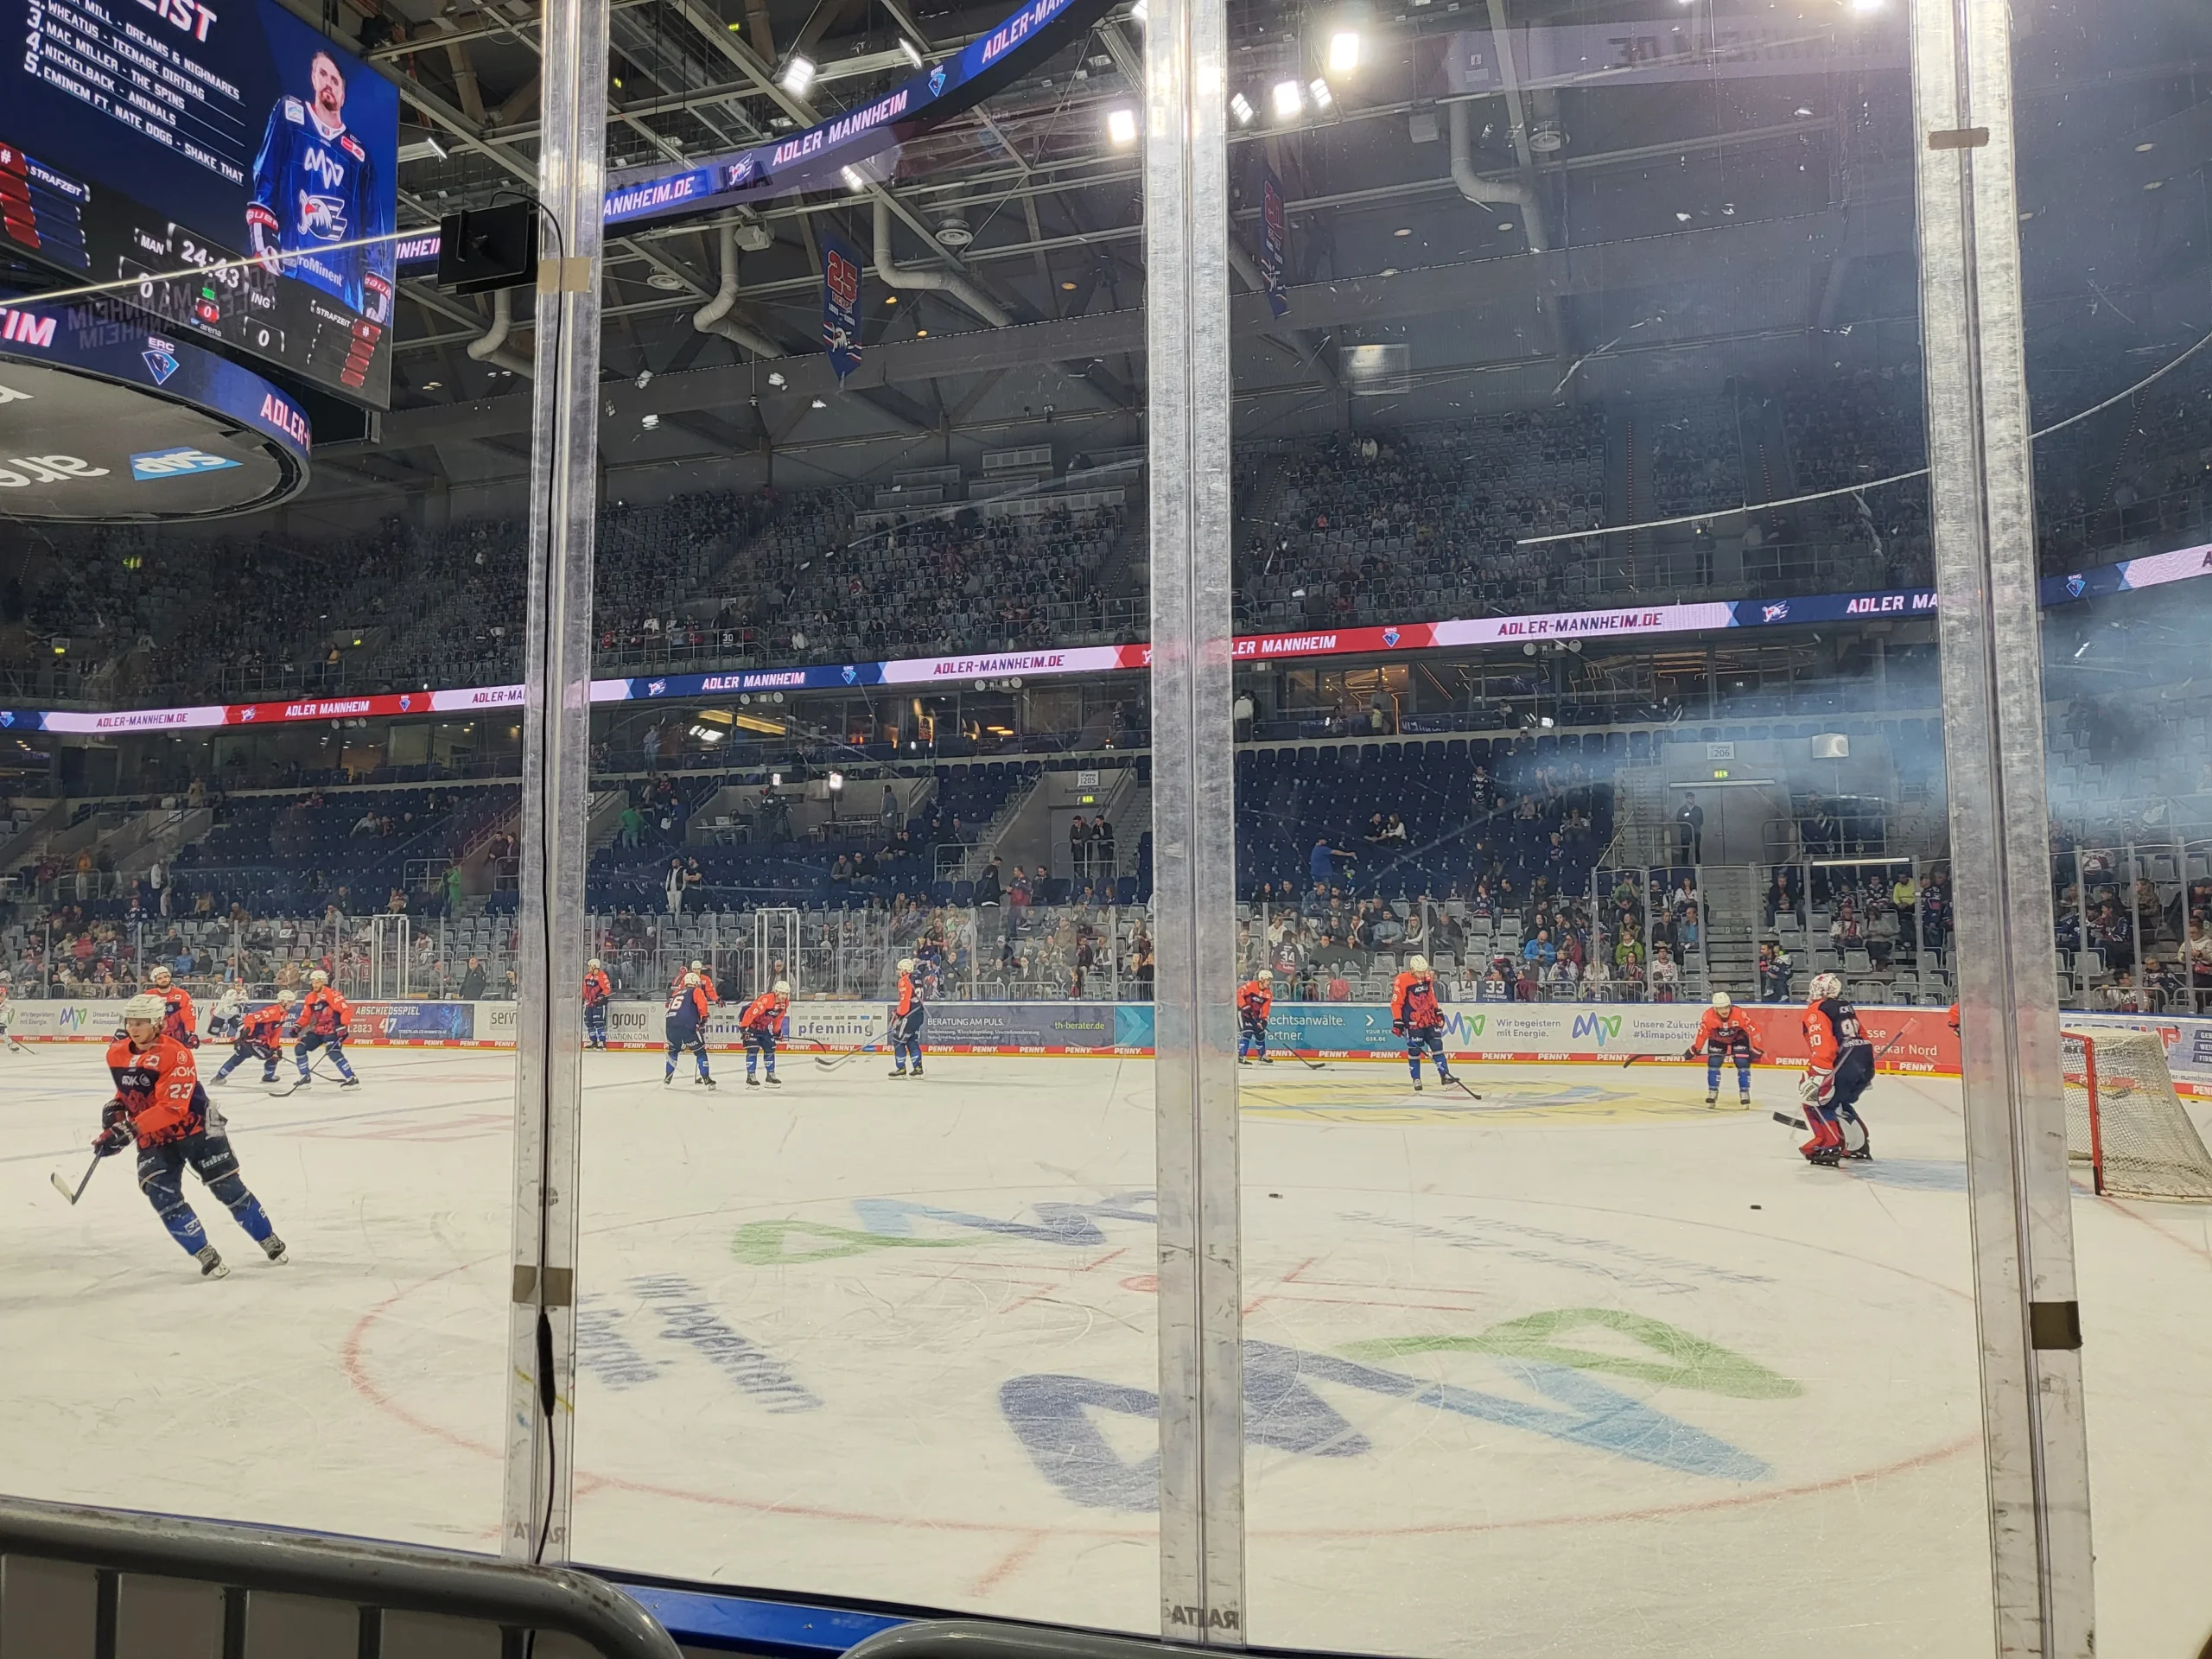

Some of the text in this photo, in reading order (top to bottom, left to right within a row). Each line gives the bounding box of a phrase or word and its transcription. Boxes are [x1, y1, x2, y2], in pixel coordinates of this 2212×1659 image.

[48, 0, 99, 39] WHEATUS
[112, 36, 159, 73] TEENAGE
[162, 67, 205, 100] DIRTBAG
[85, 1, 113, 24] MILL
[125, 22, 168, 57] DREAMS
[172, 51, 181, 65] &
[184, 58, 239, 99] NIGHMARES
[27, 7, 44, 33] 3.
[46, 21, 72, 45] MAC
[75, 38, 118, 72] MILLER
[130, 69, 150, 90] THE
[154, 83, 185, 110] SPINS
[26, 31, 44, 55] 4.
[45, 43, 115, 92] NICKELBACK
[129, 91, 176, 125] ANIMALS
[44, 66, 91, 100] EMINEM
[94, 93, 111, 112] FT.
[115, 104, 143, 129] NATE
[145, 121, 173, 145] DOGG
[184, 143, 217, 169] SHAKE
[220, 162, 244, 183] THAT
[772, 90, 908, 167] ADLER MANNHEIM
[29, 166, 82, 196] STRAFZEIT
[140, 235, 165, 256] MAN
[828, 250, 857, 302] 25
[251, 292, 271, 309] ING
[203, 306, 213, 318] 0
[315, 306, 352, 328] STRAFZEIT
[200, 323, 222, 338] arena
[258, 329, 270, 347] 0
[149, 336, 175, 351] ERC
[1846, 595, 1904, 613] ADLER
[1497, 613, 1663, 636] ADLER-MANNHEIM.DE
[722, 633, 734, 642] 30
[1262, 635, 1337, 653] MANNHEIM
[933, 654, 1065, 675] ADLER-MANNHEIM.DE
[702, 672, 805, 690] ADLER MANNHEIM
[285, 700, 370, 716] ADLER MANNHEIM
[96, 713, 188, 728] ADLER-MANNHEIM.DE
[1280, 950, 1295, 963] 34
[1485, 980, 1506, 994] 33
[355, 1006, 421, 1016] ABSCHIEDSSPIEL
[378, 1018, 397, 1033] 47
[612, 1013, 646, 1029] group
[705, 1021, 741, 1033] nnin
[798, 1022, 874, 1036] pfenning
[927, 1018, 1004, 1027] BERATUNG AM PULS.
[1054, 1021, 1104, 1030] th-berater.de
[1497, 1019, 1561, 1028] Wir begeistern
[1513, 1029, 1549, 1039] Energie.
[1908, 1045, 1937, 1056] Nord
[1776, 1057, 1811, 1065] PENNY.
[1899, 1062, 1936, 1071] PENNY.
[169, 1083, 194, 1099] 23
